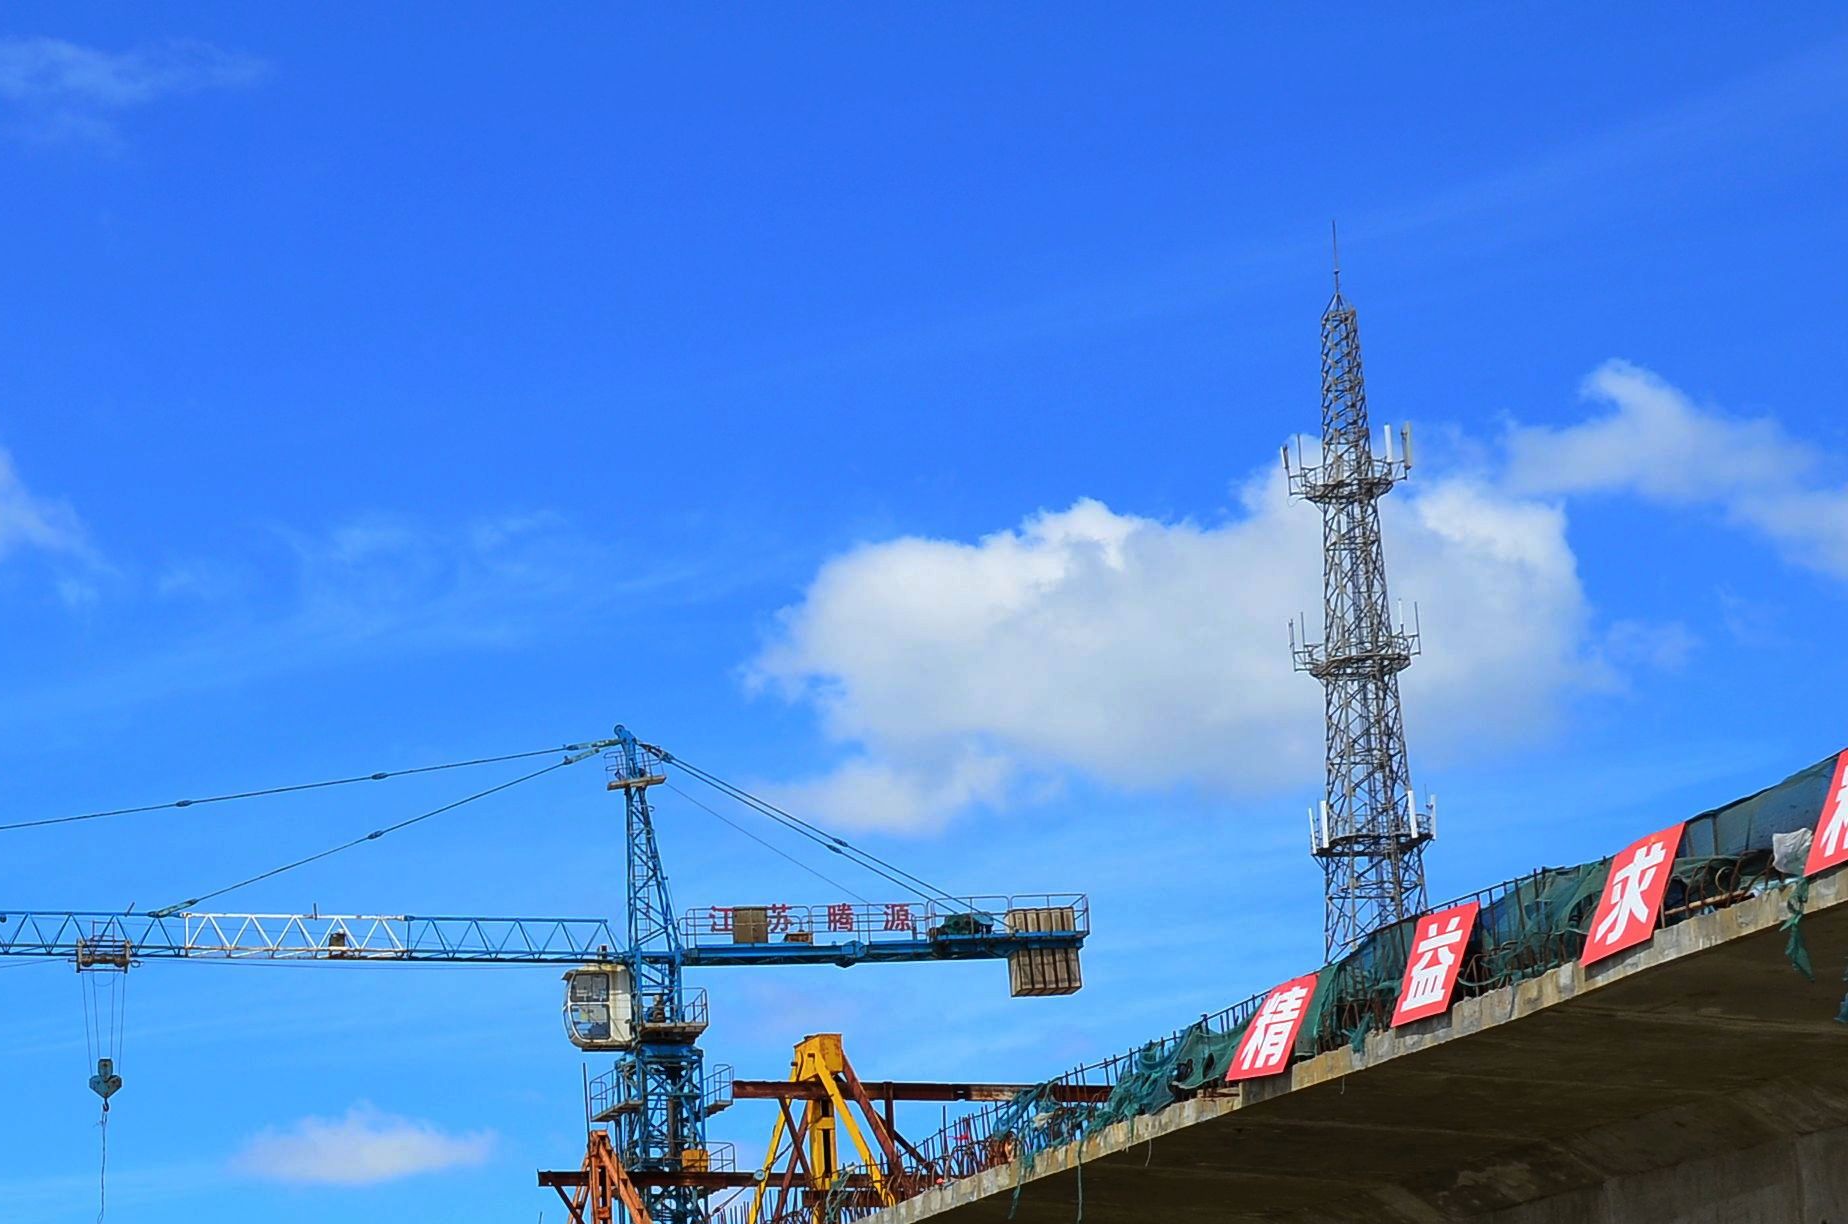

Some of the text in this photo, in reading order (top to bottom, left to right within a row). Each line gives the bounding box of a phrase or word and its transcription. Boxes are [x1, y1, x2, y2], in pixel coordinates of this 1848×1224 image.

[709, 903, 914, 932] 江苏腾源
[1239, 841, 1666, 1070] 精 益 求
